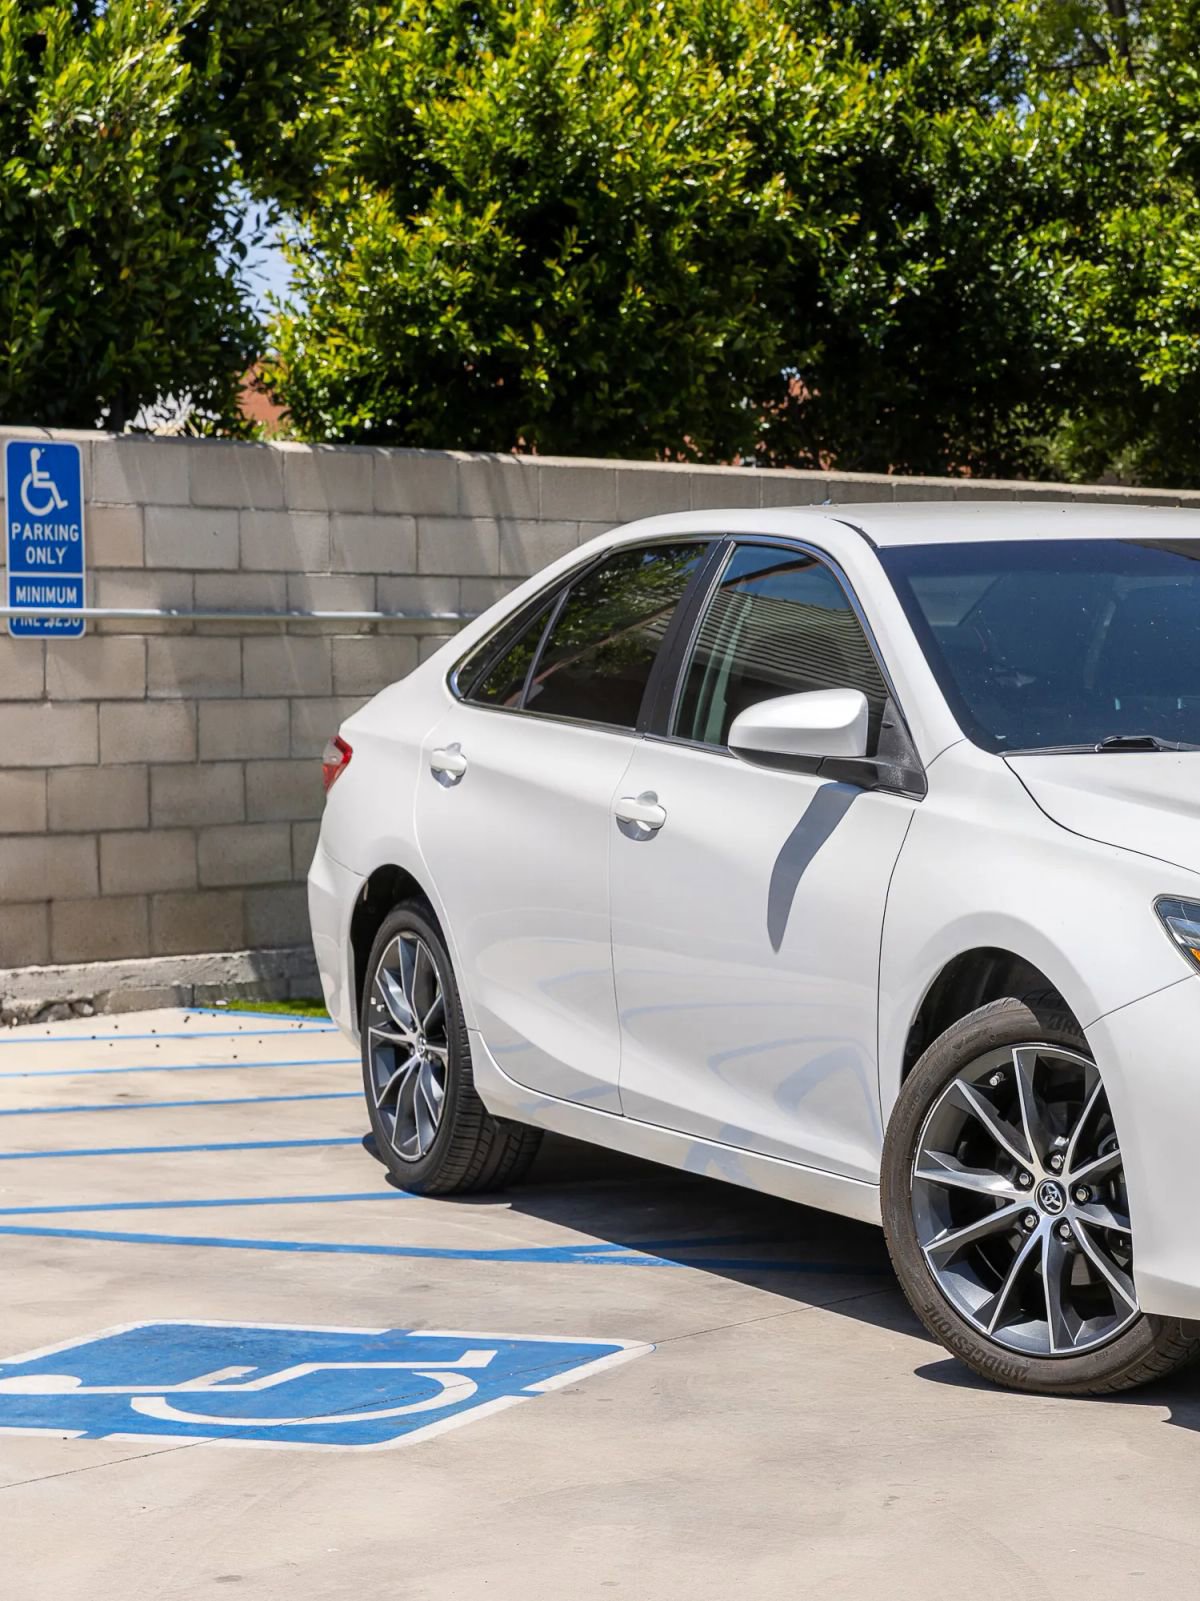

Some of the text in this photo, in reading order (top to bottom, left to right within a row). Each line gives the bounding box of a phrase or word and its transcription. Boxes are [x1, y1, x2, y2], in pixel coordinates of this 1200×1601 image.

[11, 522, 79, 542] PARKING
[26, 546, 67, 564] ONLY
[16, 585, 77, 604] MINIMUM
